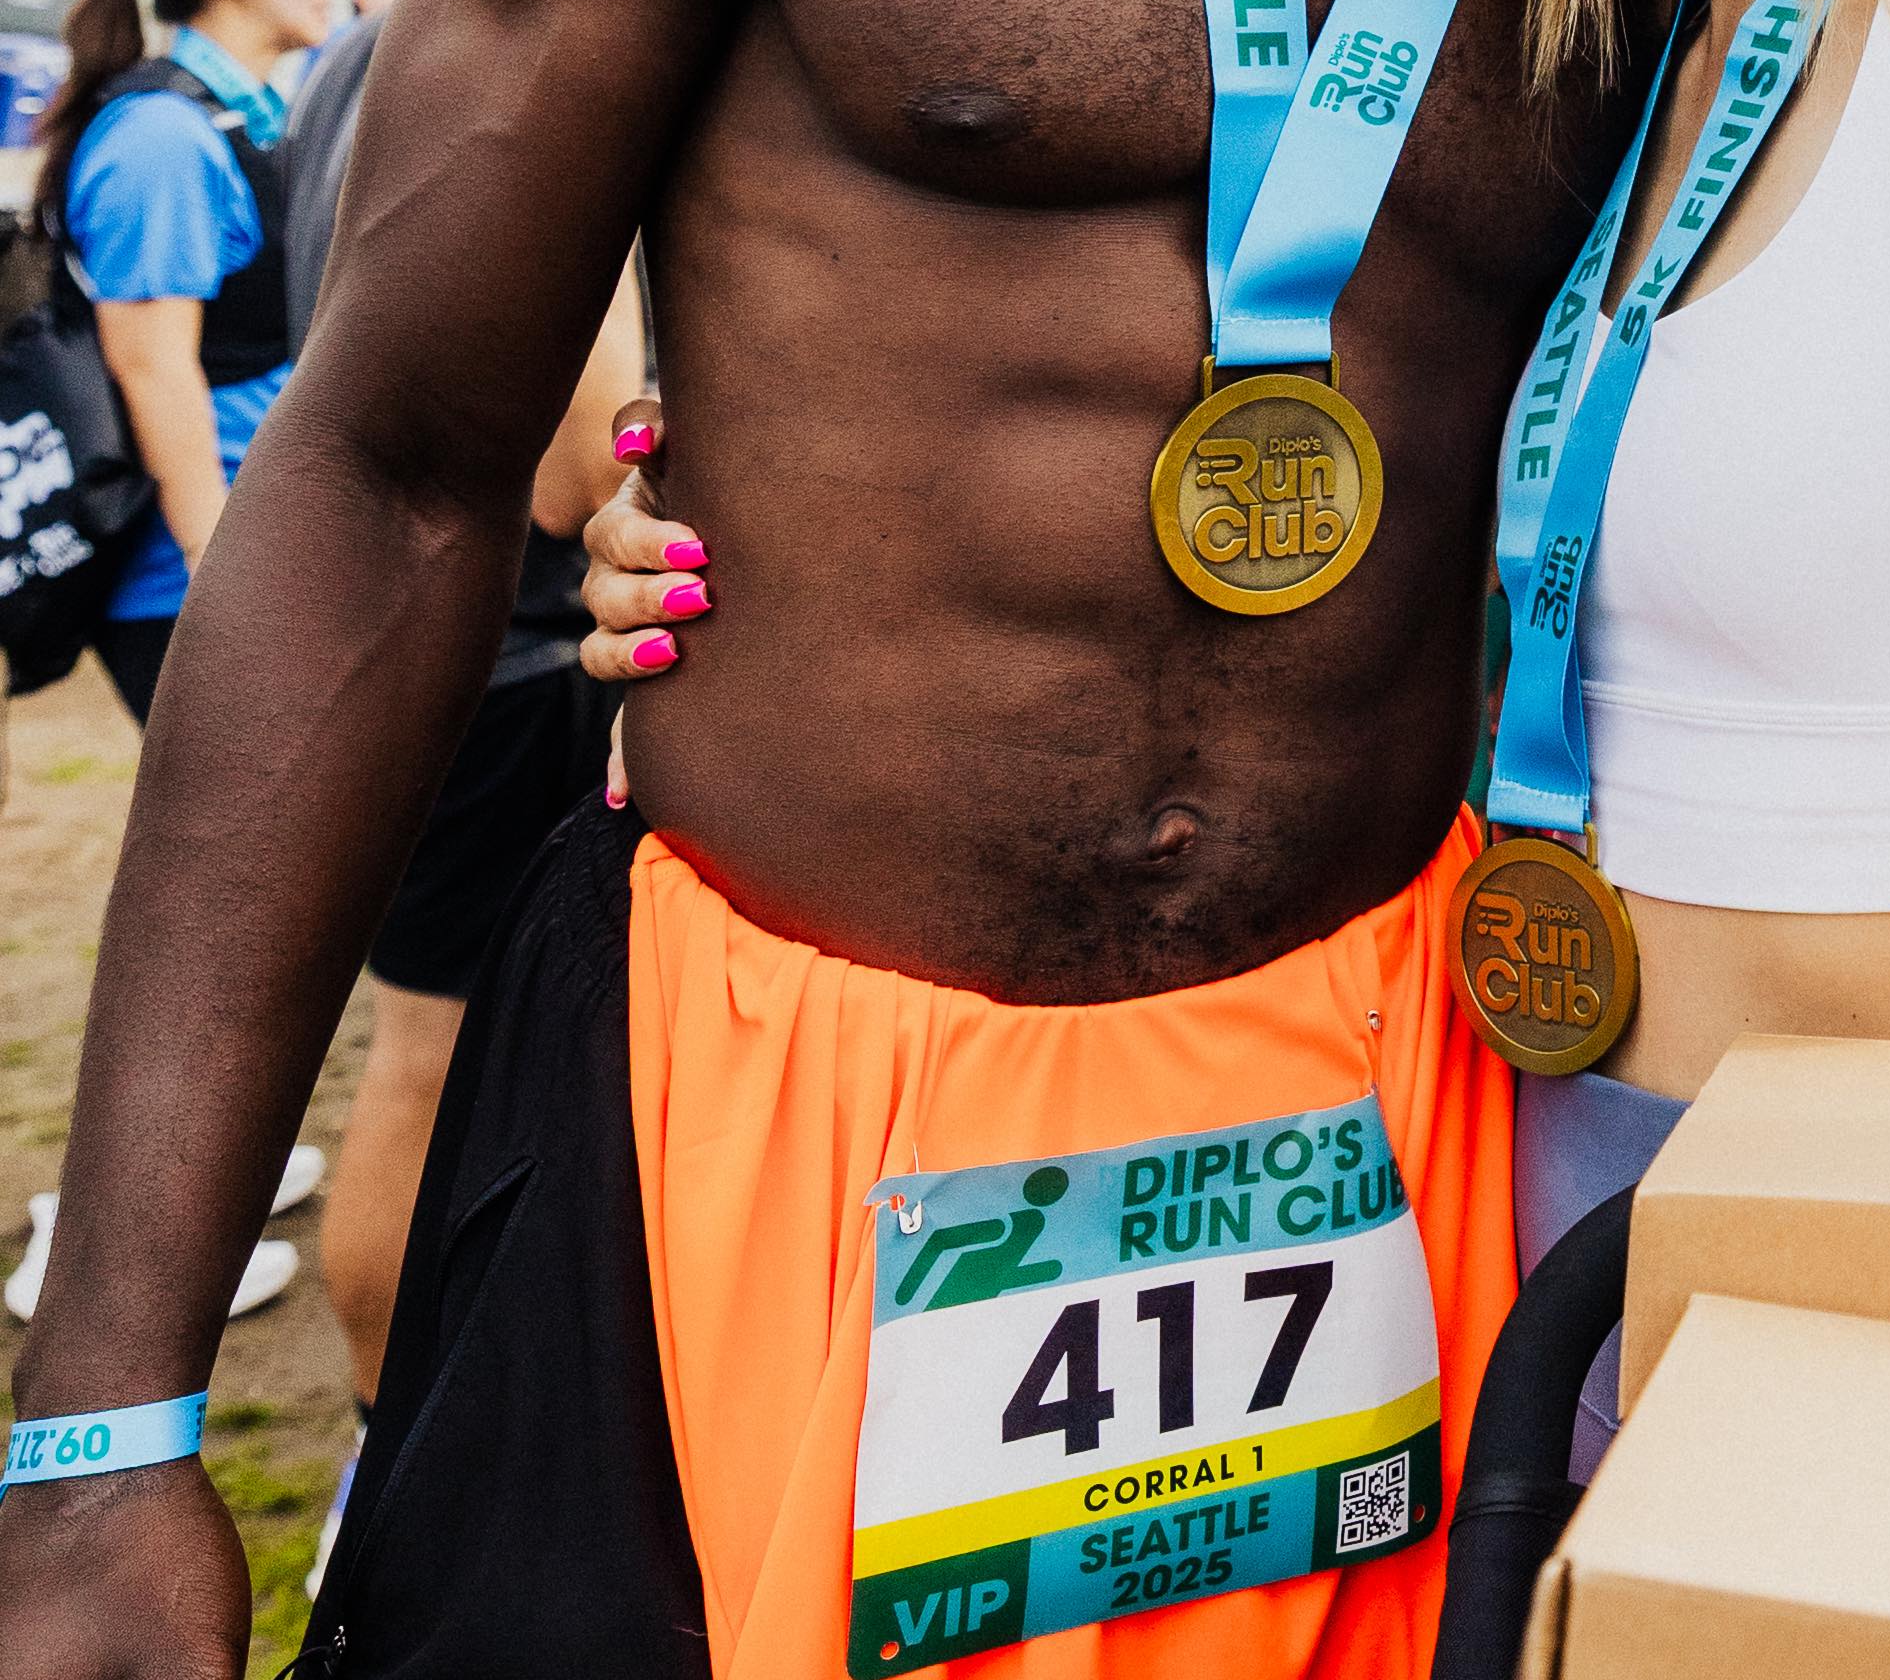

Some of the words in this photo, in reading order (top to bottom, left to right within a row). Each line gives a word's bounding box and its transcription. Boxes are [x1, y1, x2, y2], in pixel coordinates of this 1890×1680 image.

[1309, 30, 1383, 112] Run
[1357, 41, 1418, 125] Club
[1619, 254, 1682, 347] 5K
[1517, 211, 1617, 481] SEATTLE
[1196, 439, 1336, 505] Run
[1269, 436, 1322, 456] Diplo's
[1194, 500, 1344, 563] Club
[1475, 892, 1592, 971] Run
[1533, 902, 1579, 924] Diplo's
[1475, 957, 1600, 1028] Club
[1122, 1118, 1364, 1207] DIPLO'S
[1119, 1191, 1251, 1261] RUN
[1001, 1260, 1334, 1457] 417
[1083, 1453, 1235, 1512] CORRAL
[1252, 1446, 1265, 1472] 1
[1080, 1493, 1269, 1574] SEATTLE
[894, 1578, 1010, 1647] VIP
[1110, 1557, 1233, 1609] 2025
